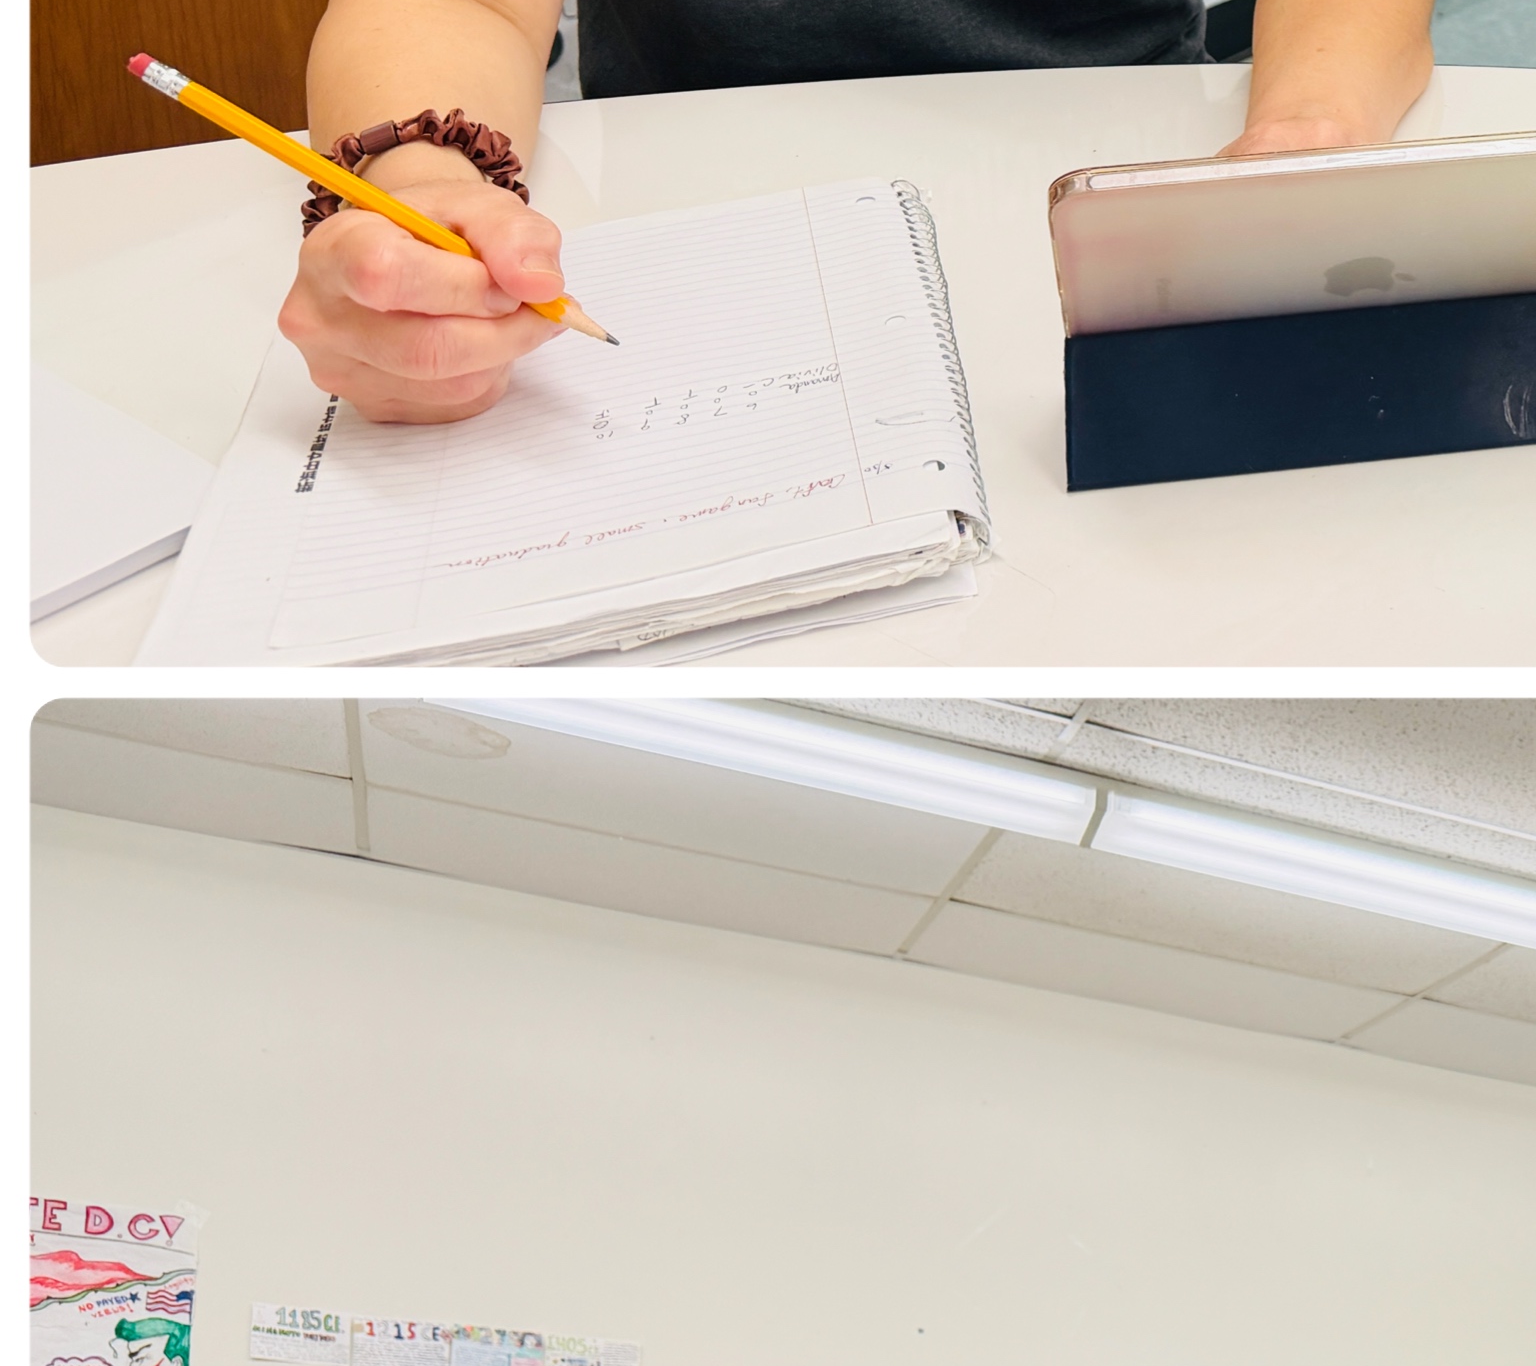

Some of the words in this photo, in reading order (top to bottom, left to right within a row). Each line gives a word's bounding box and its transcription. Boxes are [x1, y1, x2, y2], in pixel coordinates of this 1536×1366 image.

[778, 361, 840, 381] Olivia
[778, 372, 840, 393] Amanda
[583, 521, 647, 545] small
[78, 1302, 94, 1313] NO
